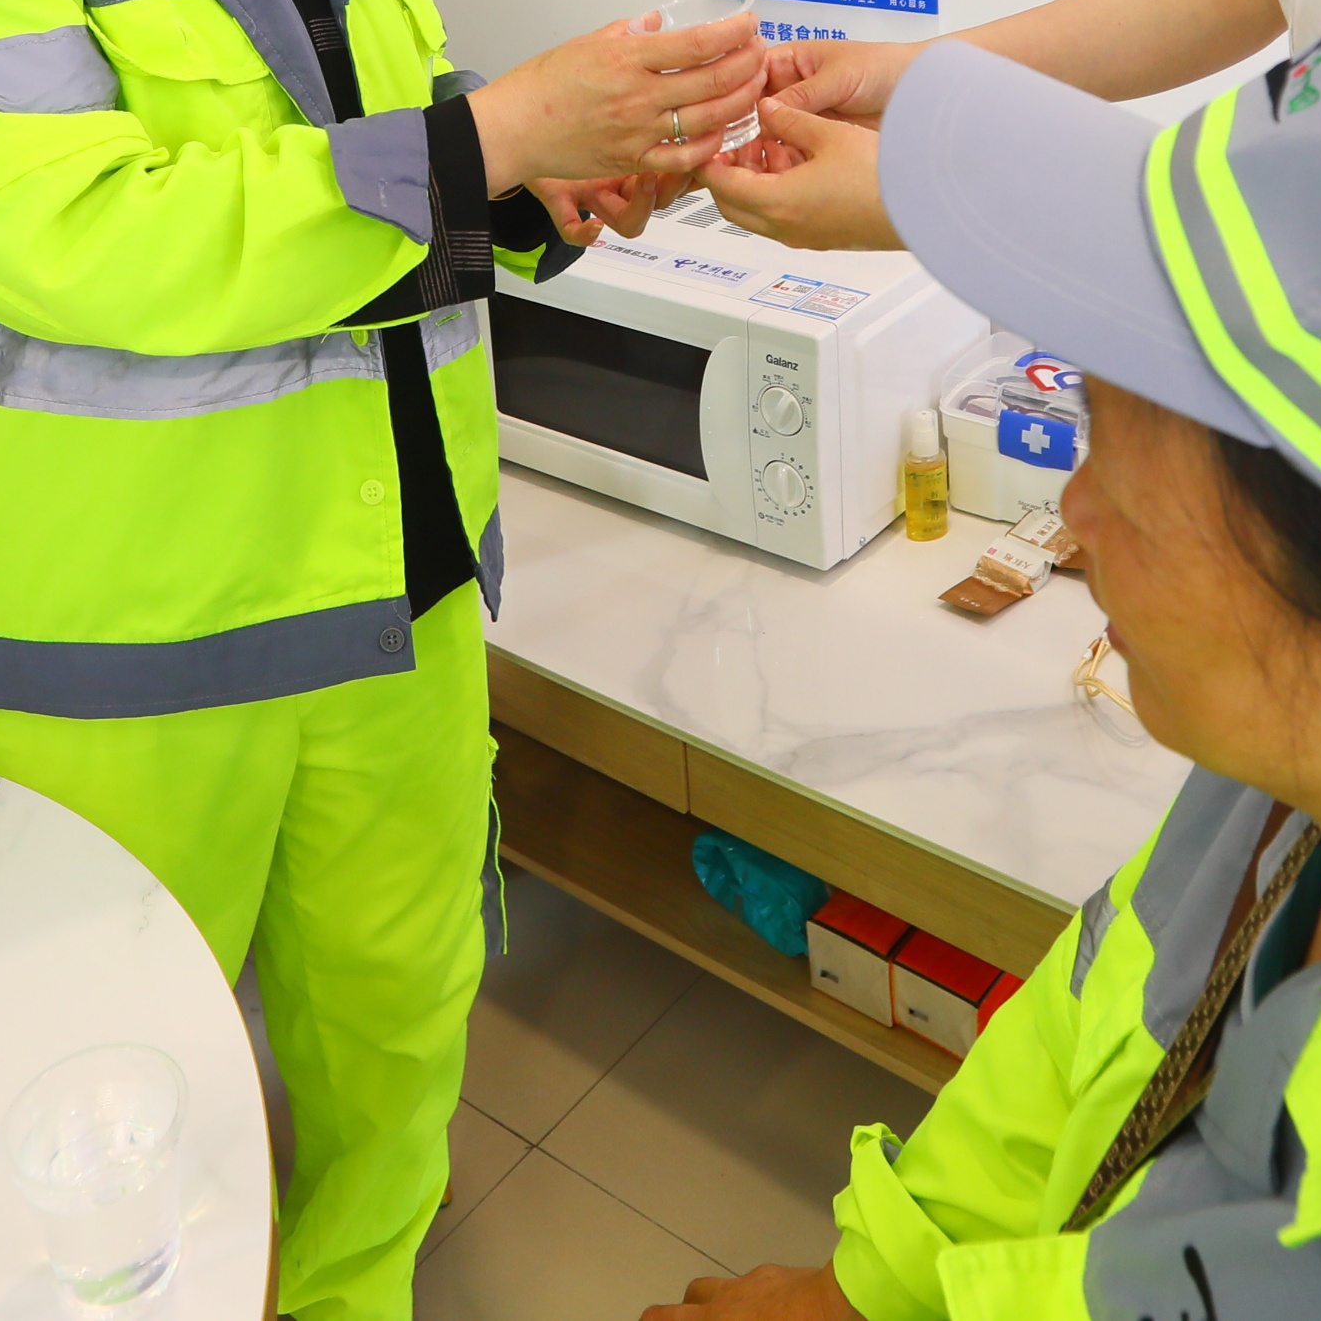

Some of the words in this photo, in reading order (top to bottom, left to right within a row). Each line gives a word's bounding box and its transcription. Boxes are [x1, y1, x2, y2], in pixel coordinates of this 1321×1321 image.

[604, 243, 660, 262] 江西省总工会
[696, 262, 748, 280] 中国电信
[765, 354, 799, 372] Galanz
